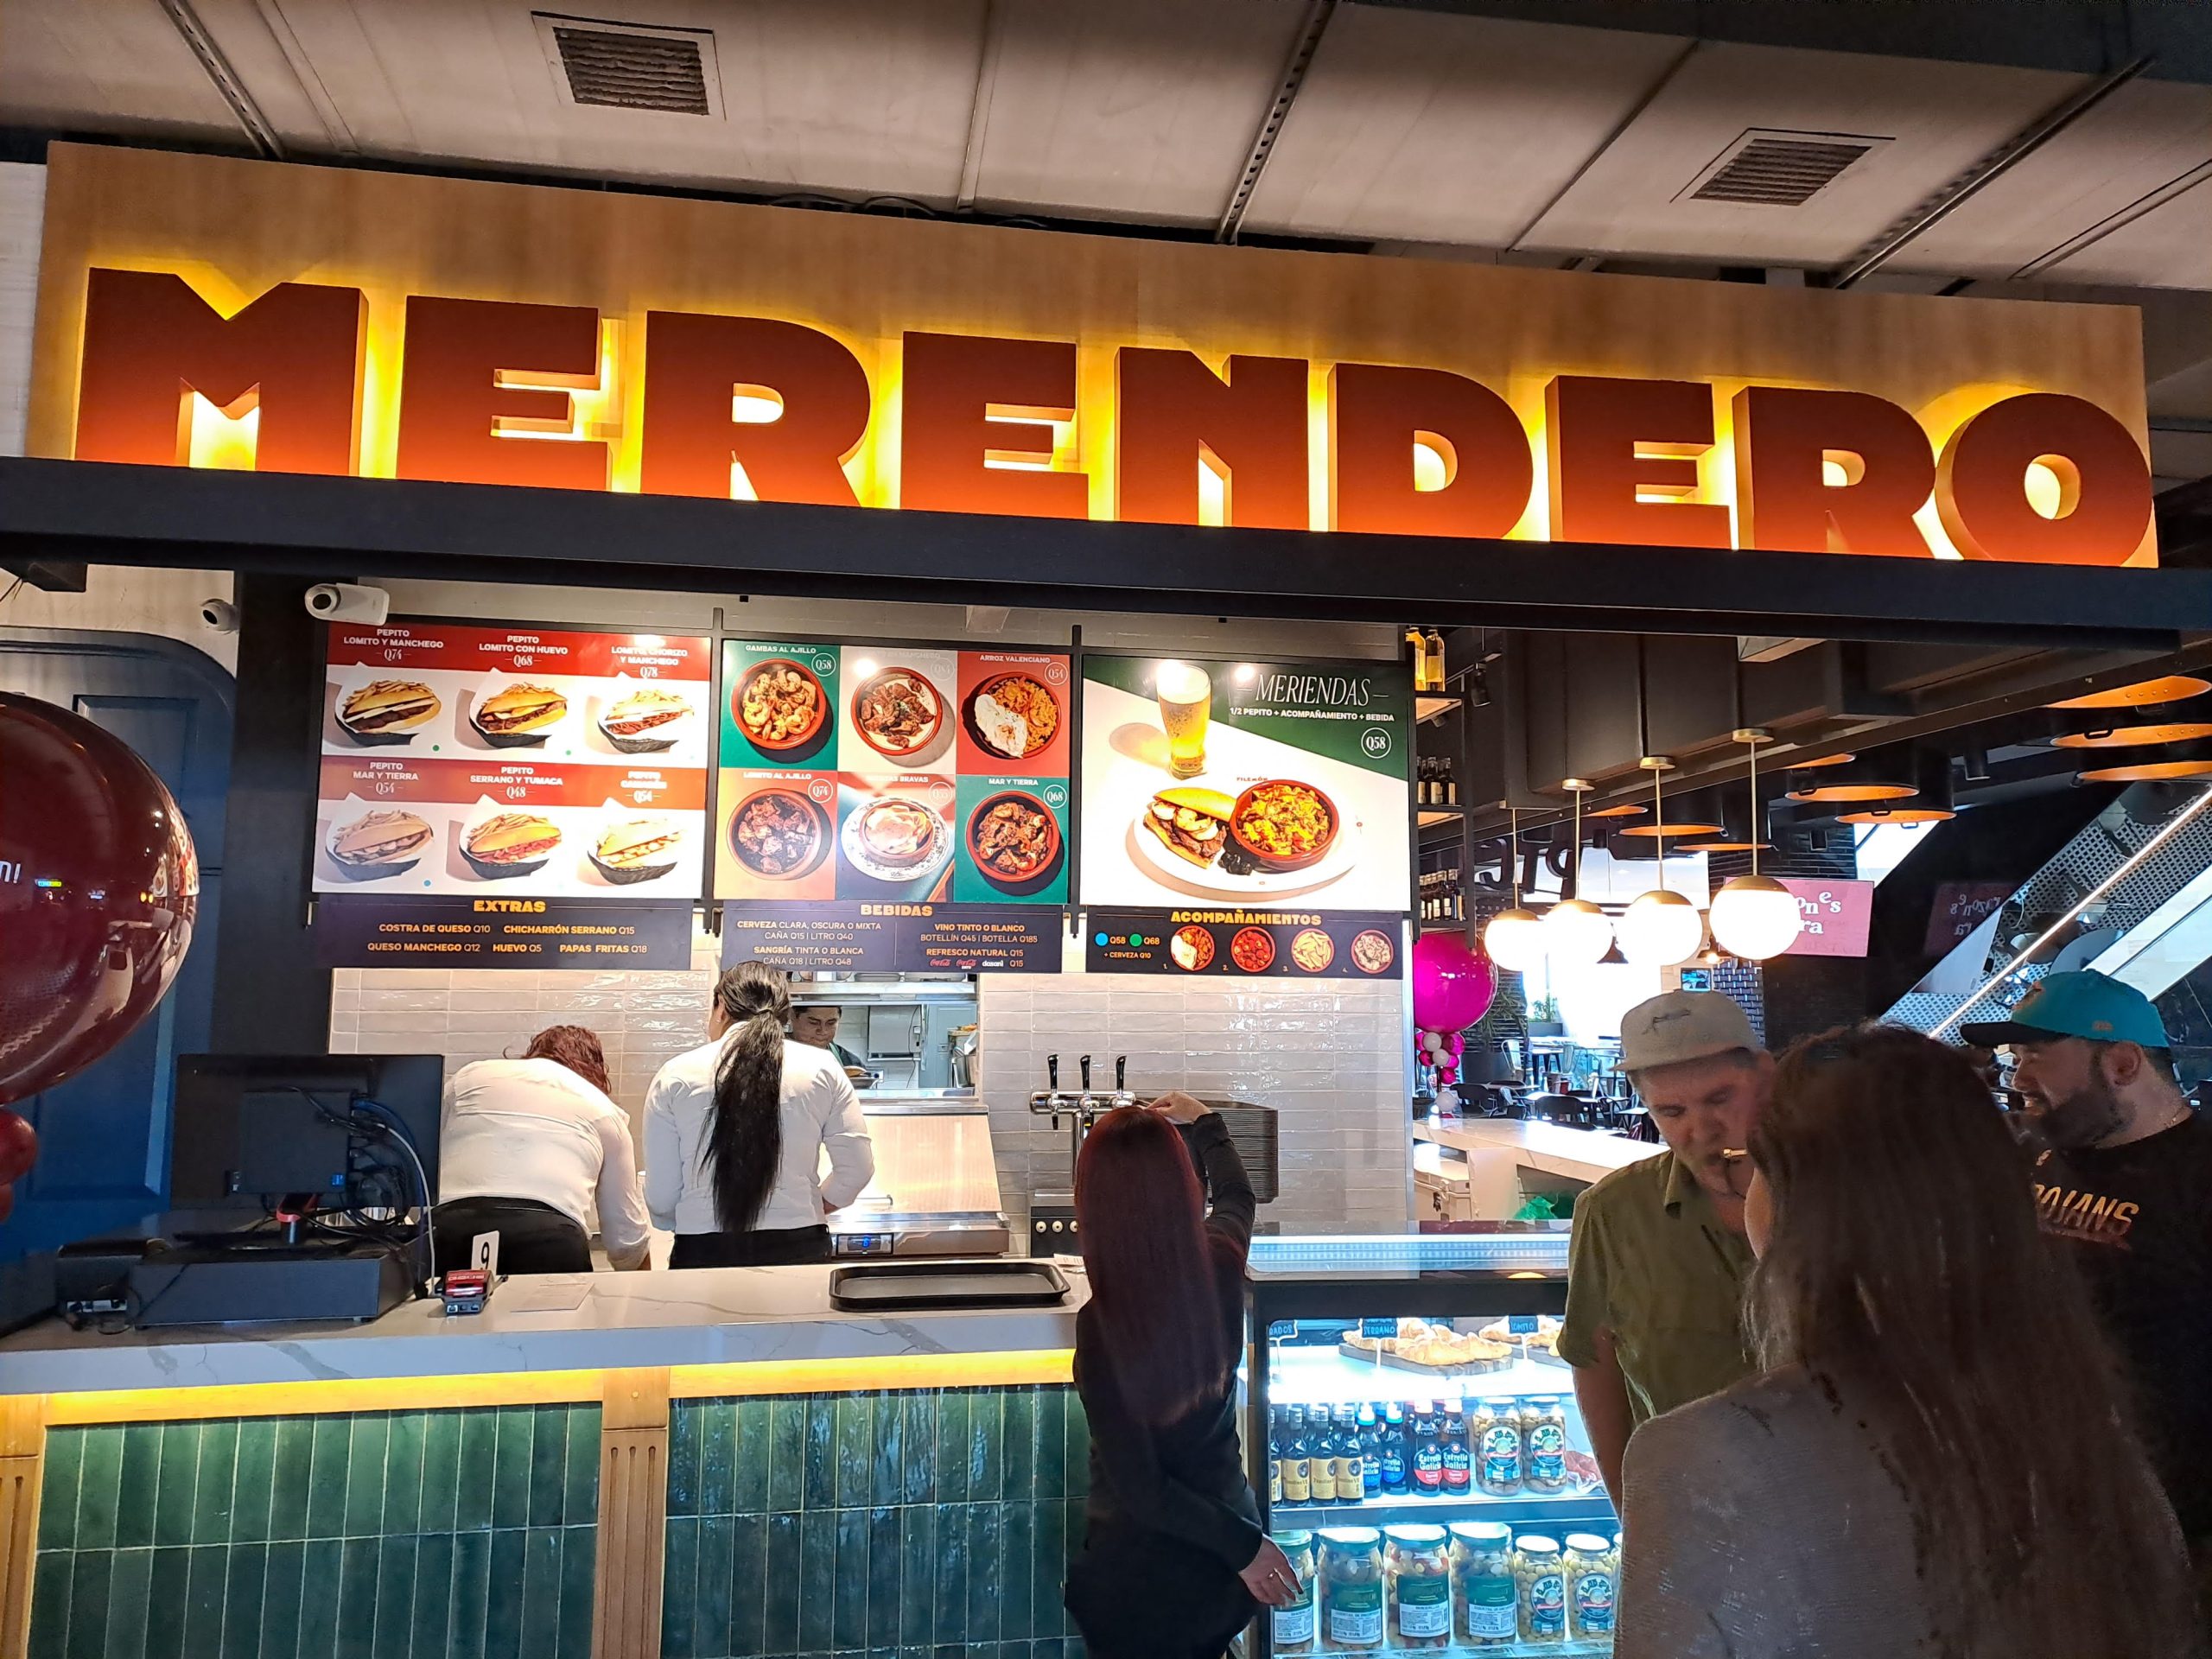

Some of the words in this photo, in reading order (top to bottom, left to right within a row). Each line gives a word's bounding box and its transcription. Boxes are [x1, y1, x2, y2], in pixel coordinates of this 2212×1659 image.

[75, 267, 2152, 566] MERENDERO
[344, 637, 379, 645] LOMITO
[390, 639, 443, 648] MANCHEGO
[507, 635, 539, 644] PEPITO
[479, 643, 513, 652] LOMITO
[515, 645, 535, 653] CON
[537, 645, 569, 655] HUEVO
[745, 645, 776, 653] GAMBAS
[385, 649, 402, 661] Q74
[513, 655, 532, 666] Q68
[1005, 655, 1051, 664] VALENCIANO
[815, 659, 832, 671] Q58
[640, 666, 658, 678] Q78
[1255, 674, 1370, 707] MERIENDAS
[1243, 708, 1272, 716] PEPITO
[1281, 709, 1357, 720] ACOMPAÑAMIENTO
[1366, 736, 1386, 751] Q58
[370, 762, 404, 771] PEPITO
[501, 766, 534, 775] PEPITO
[376, 772, 384, 780] Y
[385, 772, 418, 781] TIERRA
[470, 775, 513, 785] SERRANO
[524, 777, 563, 785] TUMACA
[1013, 778, 1039, 786] TIERRA
[375, 782, 395, 794] Q54
[812, 785, 828, 798] Q74
[1047, 791, 1063, 803] Q68
[474, 899, 546, 913] EXTRAS
[860, 905, 932, 917] BEBIDAS
[1171, 909, 1321, 925] ACOMPAÑAMIENTOS
[378, 924, 421, 933] COSTRA
[423, 925, 435, 933] DE
[437, 925, 471, 934] QUESO
[474, 925, 491, 934] Q10
[504, 924, 569, 935] CHICHARRÓN
[571, 926, 617, 935] SERRANO
[619, 926, 635, 936] Q15
[737, 920, 777, 929] CERVEZA
[779, 921, 809, 930] CLARA,
[765, 931, 788, 939] CAÑA
[920, 933, 958, 942] BOTELLÍN
[1144, 937, 1160, 945] Q68
[367, 943, 402, 952] QUESO
[404, 944, 462, 953] MANCHEGO
[463, 944, 480, 952] Q12
[493, 944, 527, 953] HUEVO
[529, 944, 542, 953] Q5
[559, 944, 592, 953] PAPAS
[595, 944, 629, 953] FRITAS
[631, 944, 647, 954] Q18
[753, 945, 792, 954] SANGRÍA
[763, 957, 786, 965] CAÑA
[481, 1242, 490, 1270] 9
